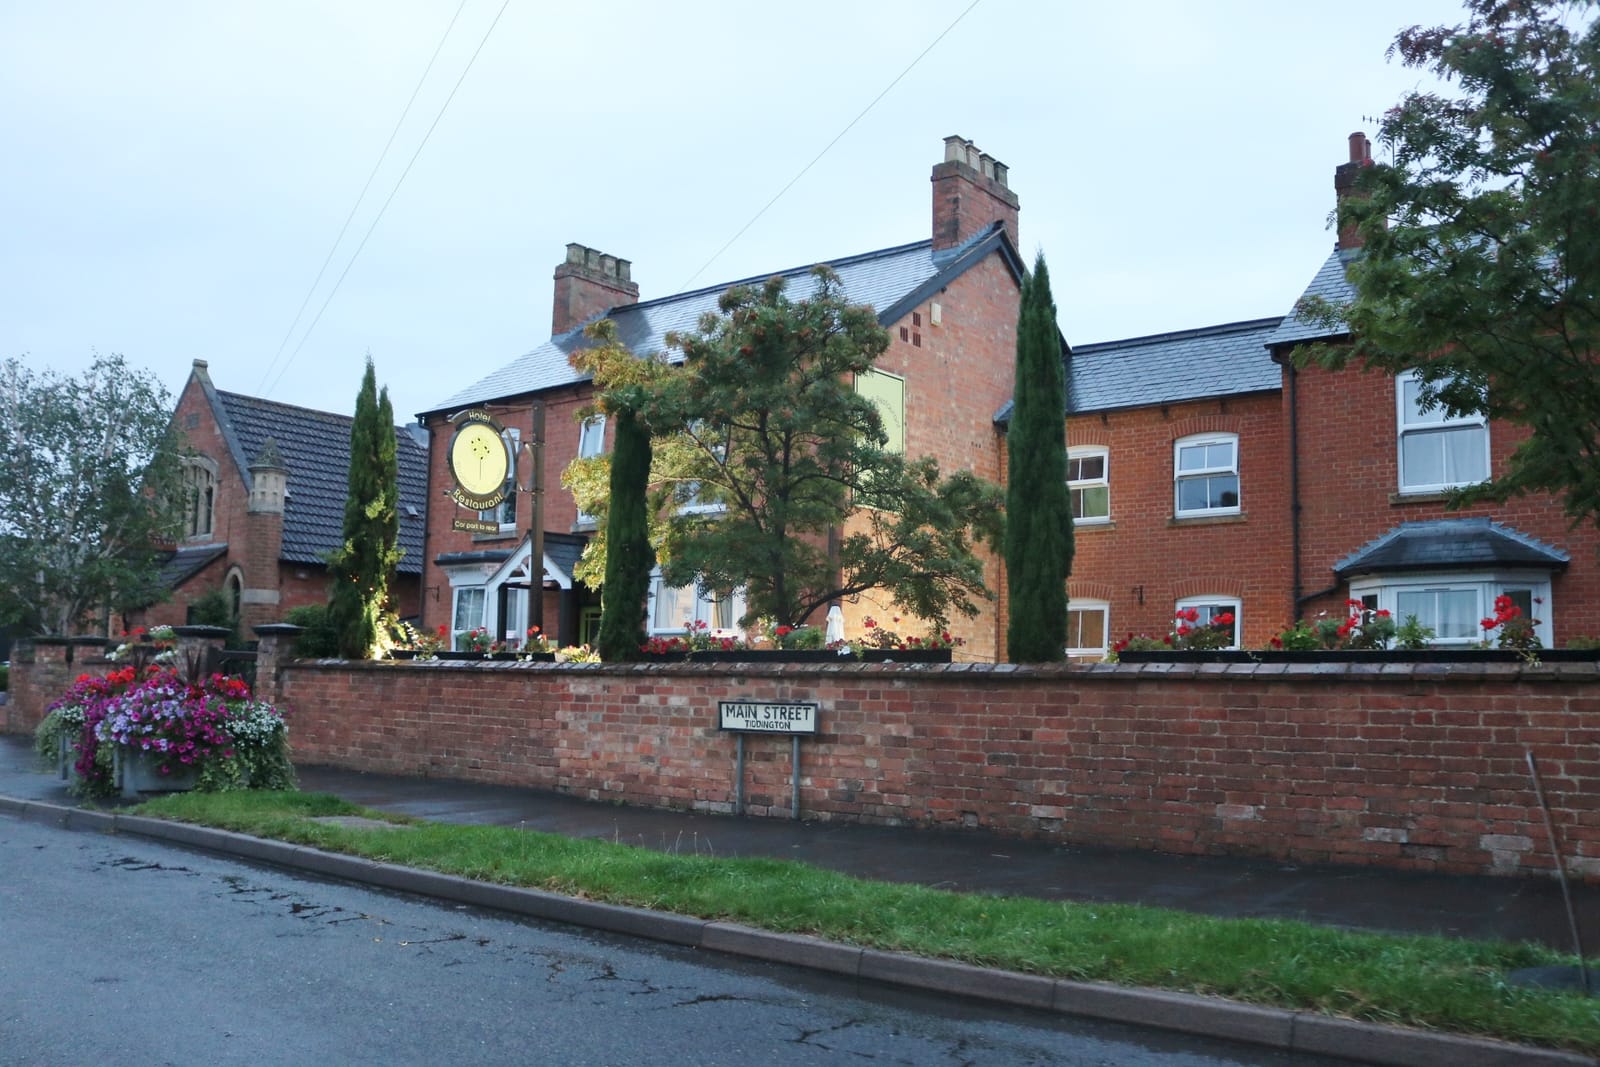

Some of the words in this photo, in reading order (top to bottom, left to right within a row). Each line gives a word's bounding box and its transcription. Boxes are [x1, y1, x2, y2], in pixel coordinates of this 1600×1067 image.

[469, 411, 491, 422] Hotel
[453, 488, 503, 509] Restaurant
[726, 705, 757, 719] MAIN
[764, 706, 811, 720] STREET
[745, 720, 791, 729] TIDDINGTON
